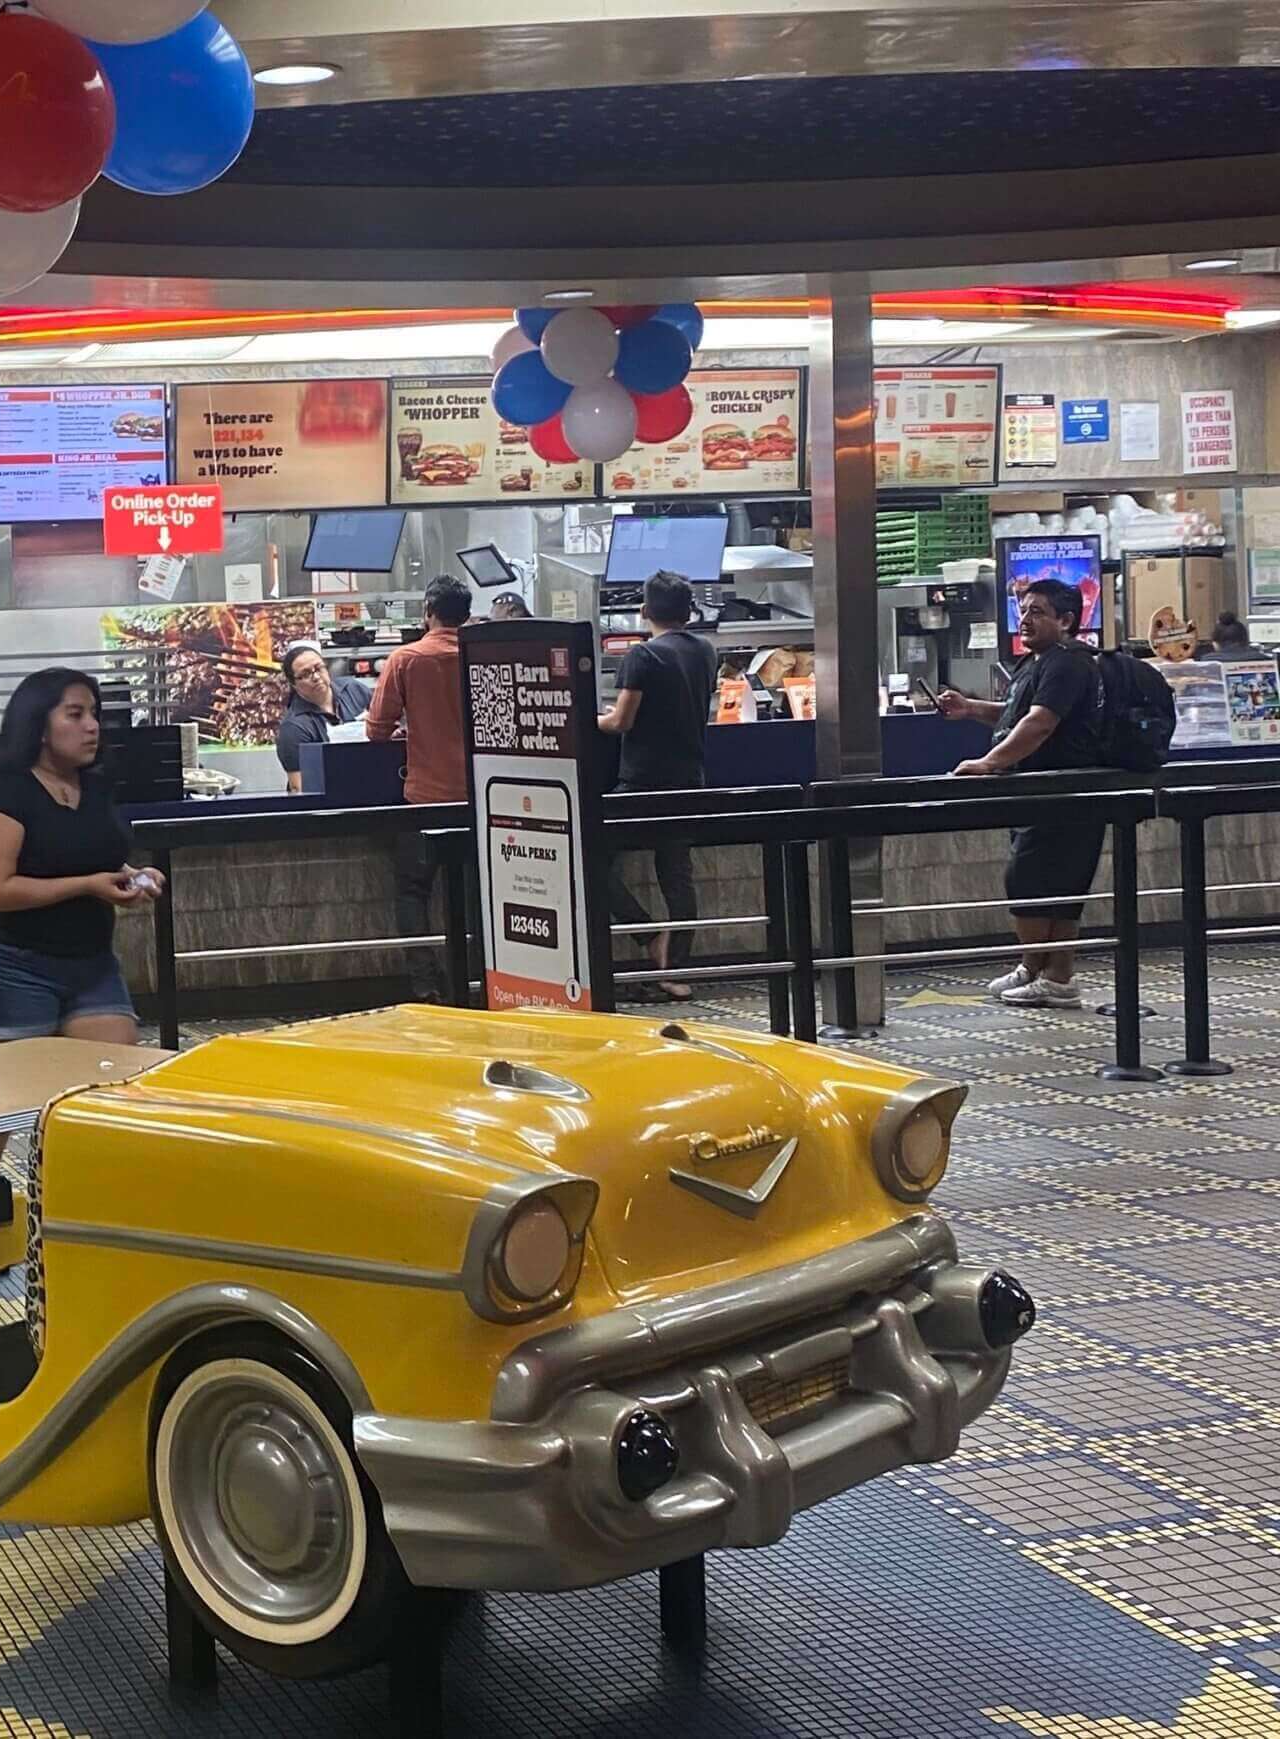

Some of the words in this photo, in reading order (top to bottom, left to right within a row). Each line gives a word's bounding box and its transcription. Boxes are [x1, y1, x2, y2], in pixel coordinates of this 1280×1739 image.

[65, 392, 113, 400] WHOPPER
[398, 396, 434, 406] Bacon
[436, 395, 444, 405] &
[446, 394, 487, 405] Cheese
[710, 391, 750, 401] ROYAL
[752, 389, 796, 403] CRISPY
[1190, 396, 1225, 408] OCCUPANCY
[404, 408, 480, 420] WHOPPER
[710, 403, 762, 413] CHICKEN
[203, 412, 247, 425] There
[249, 413, 273, 424] are
[1195, 411, 1214, 422] MORE
[1216, 410, 1232, 421] THAN
[1202, 425, 1230, 436] PERSONS
[1196, 440, 1232, 452] DANGEROUS
[193, 448, 230, 462] ways
[232, 447, 247, 458] to
[249, 445, 283, 457] have
[1198, 455, 1231, 466] UNLAWFUL
[198, 466, 206, 476] a
[111, 494, 164, 510] Online
[167, 493, 216, 508] Order
[133, 510, 195, 528] Pick-Up
[1019, 543, 1056, 552] CHOOSE
[1058, 541, 1083, 550] YOUR
[514, 663, 550, 682] Earn
[517, 686, 573, 707] Crowns
[520, 712, 535, 726] on
[536, 712, 567, 731] your
[522, 731, 559, 751] order.
[500, 844, 527, 862] ROYAL
[528, 847, 557, 861] PERKS
[510, 914, 550, 937] 123456
[494, 986, 514, 1004] Open
[516, 992, 530, 1007] the
